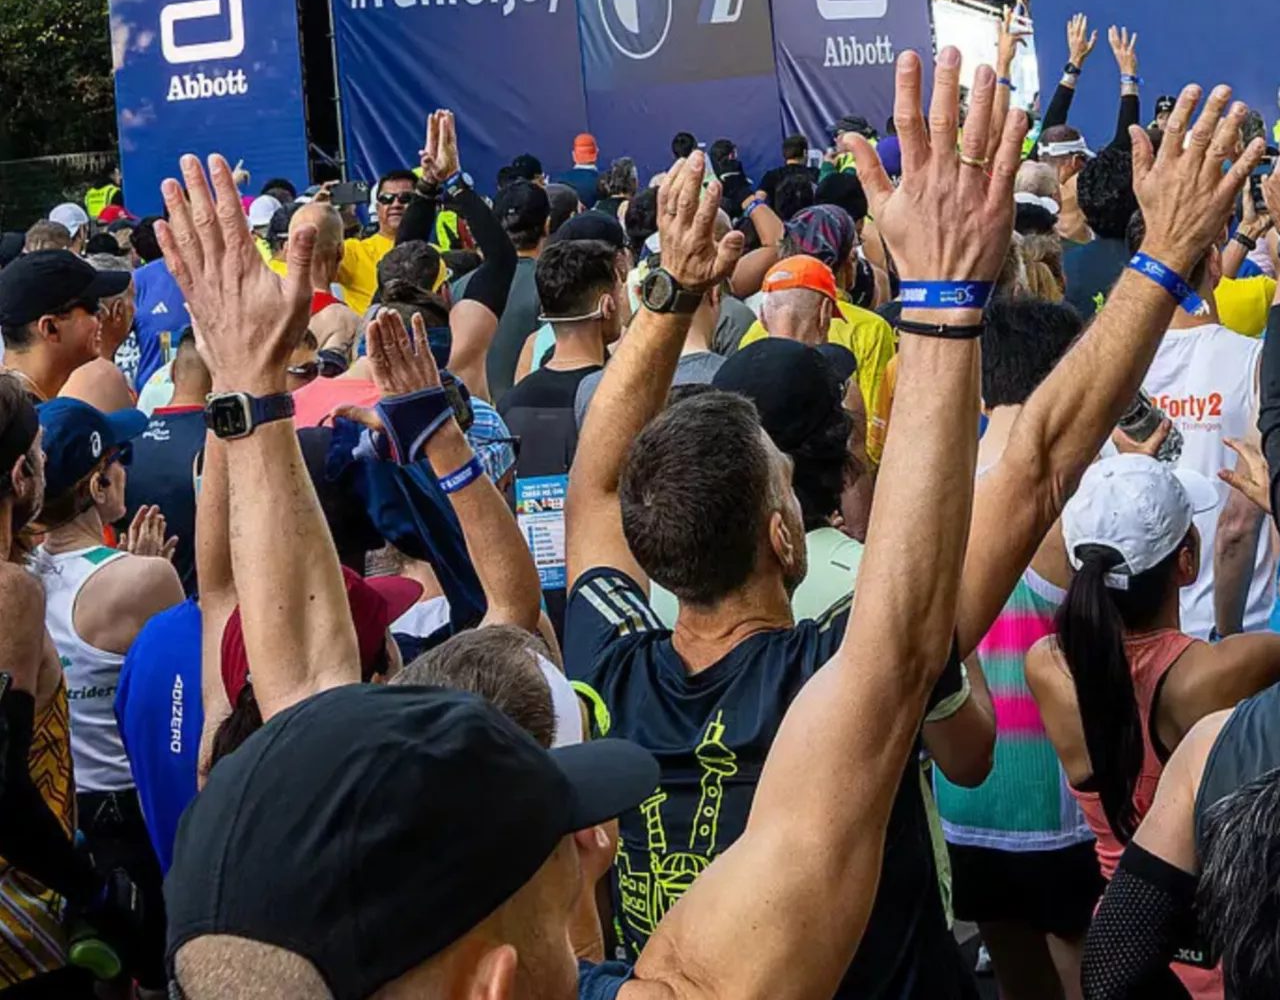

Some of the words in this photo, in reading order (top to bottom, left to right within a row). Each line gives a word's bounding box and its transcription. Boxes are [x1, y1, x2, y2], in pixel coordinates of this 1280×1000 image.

[823, 36, 895, 68] Abbott
[167, 68, 248, 102] Abbott
[170, 673, 184, 754] ADIZERO
